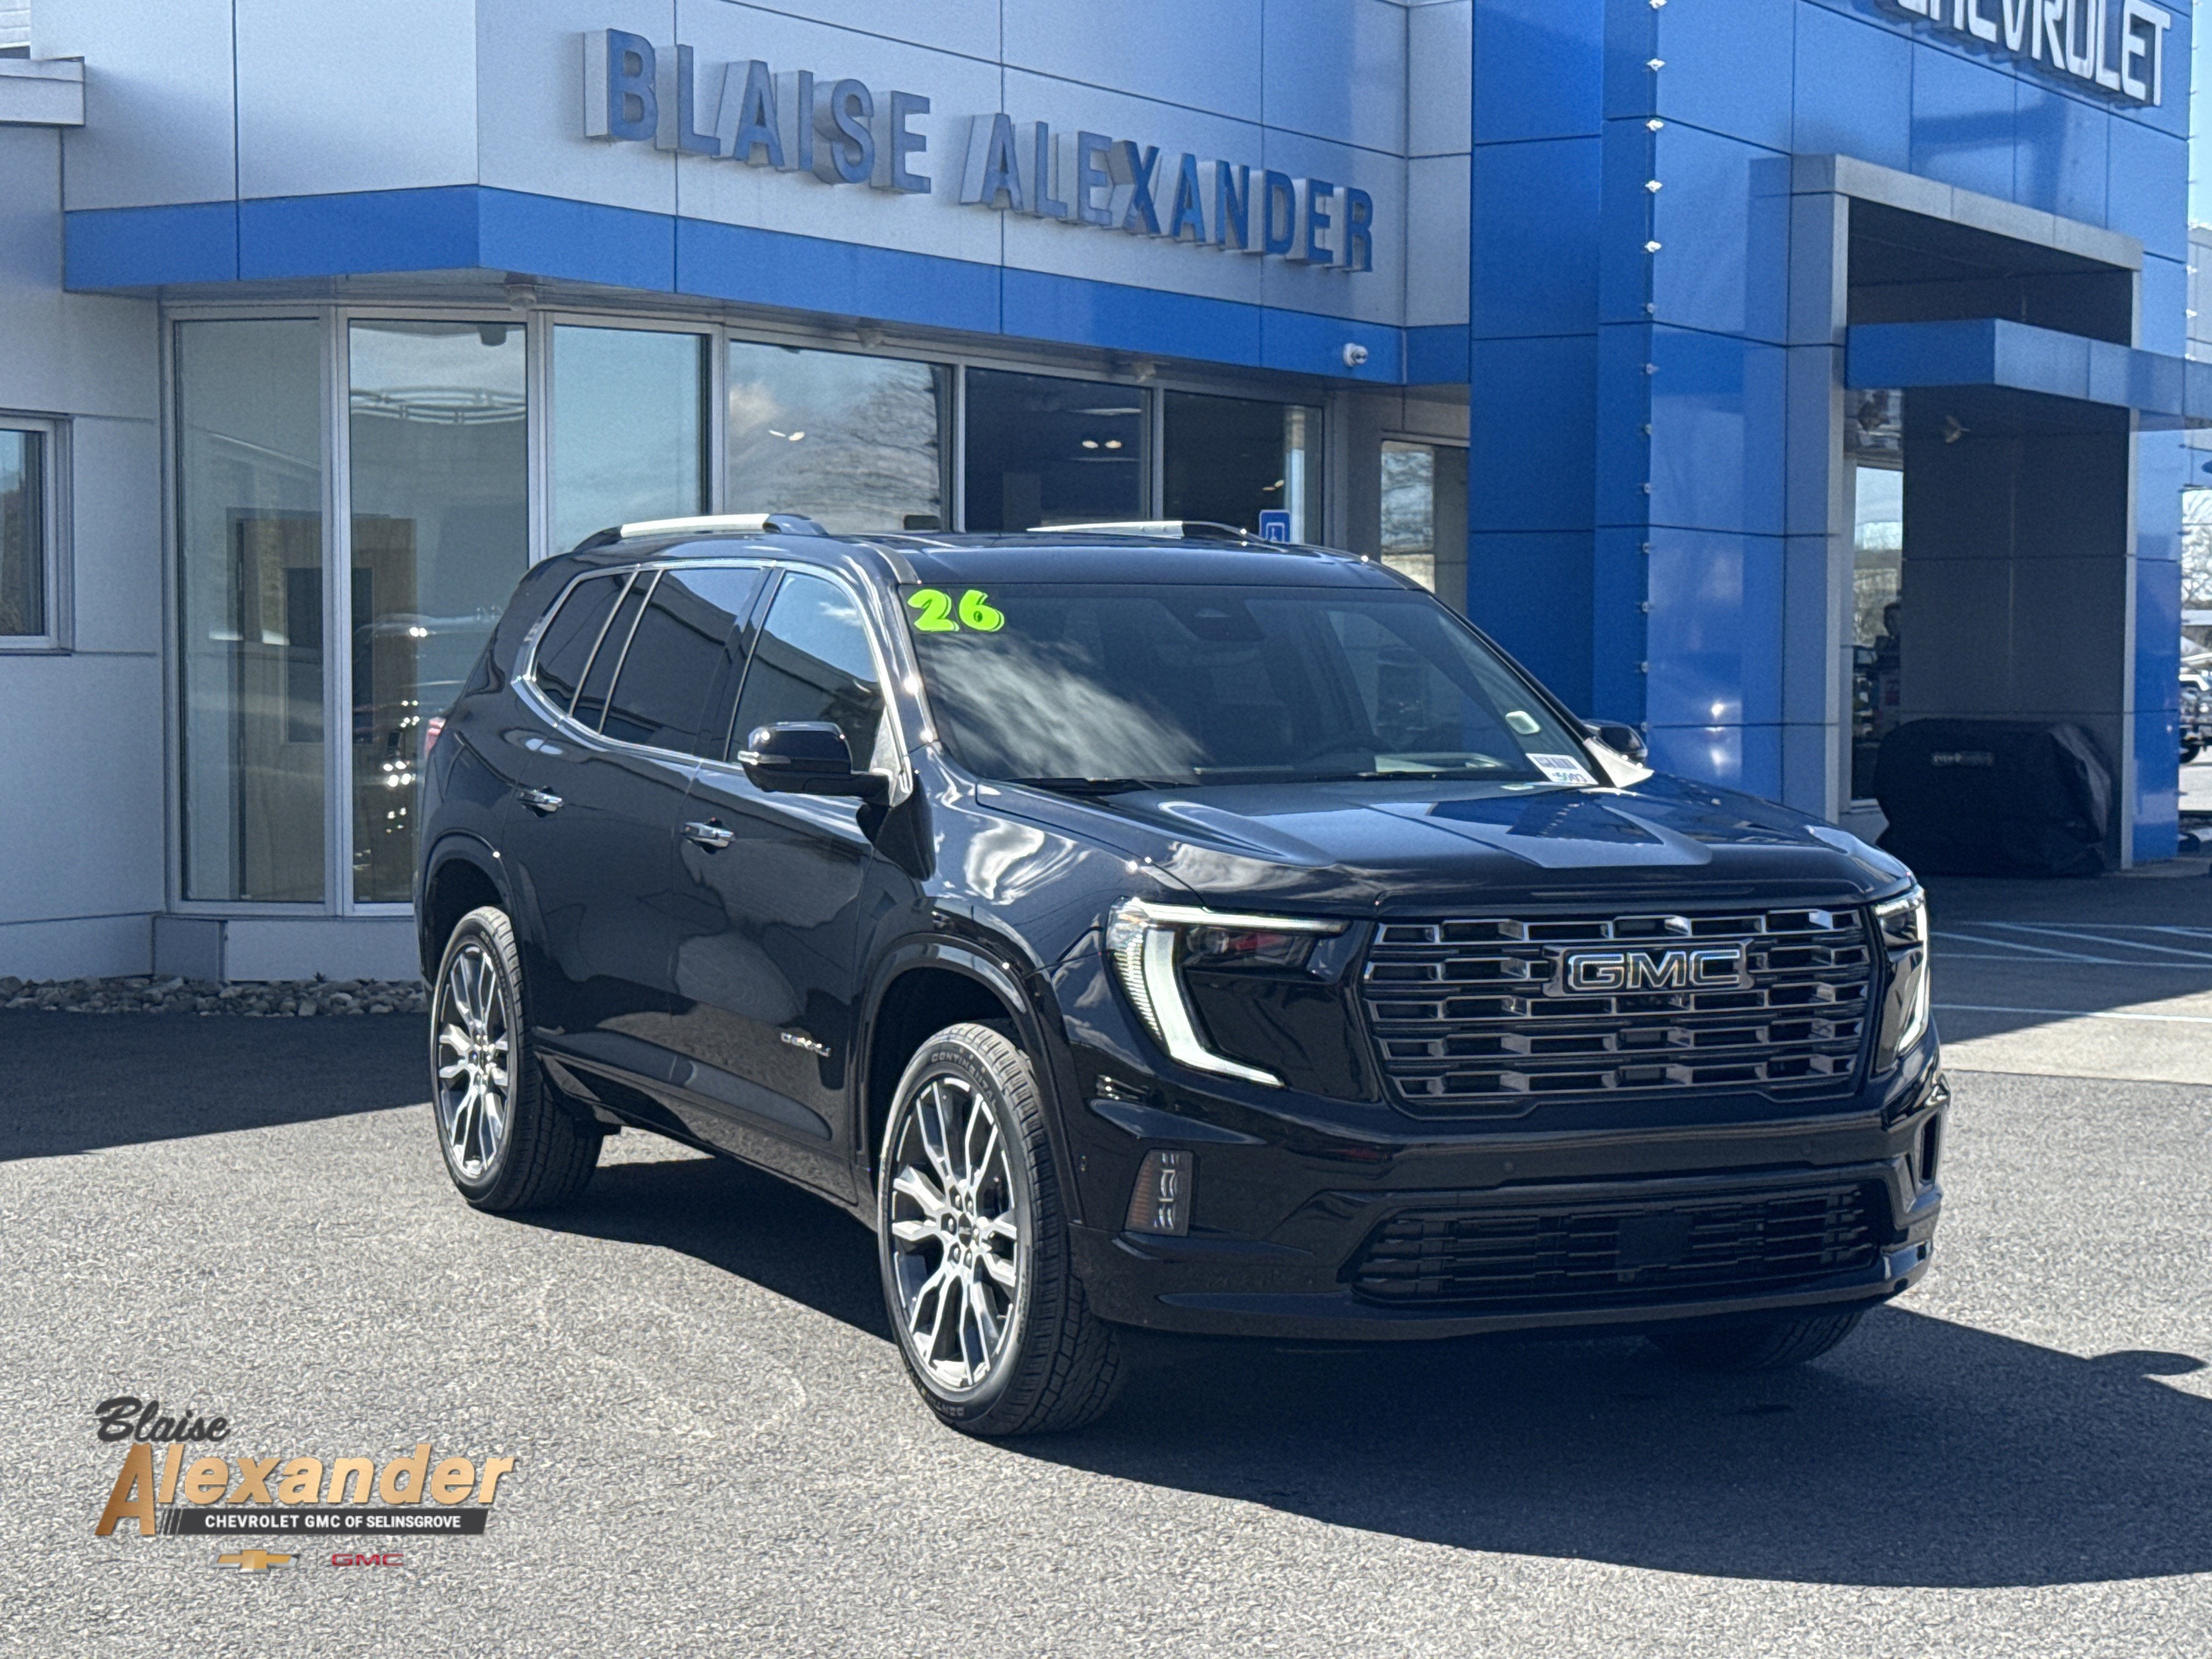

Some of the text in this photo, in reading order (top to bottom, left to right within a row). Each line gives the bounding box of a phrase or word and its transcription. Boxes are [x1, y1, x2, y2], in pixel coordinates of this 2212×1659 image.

[584, 28, 1373, 272] BLAISE ALEXANDER
[907, 589, 1005, 632] 26
[1568, 949, 1740, 991] GMC
